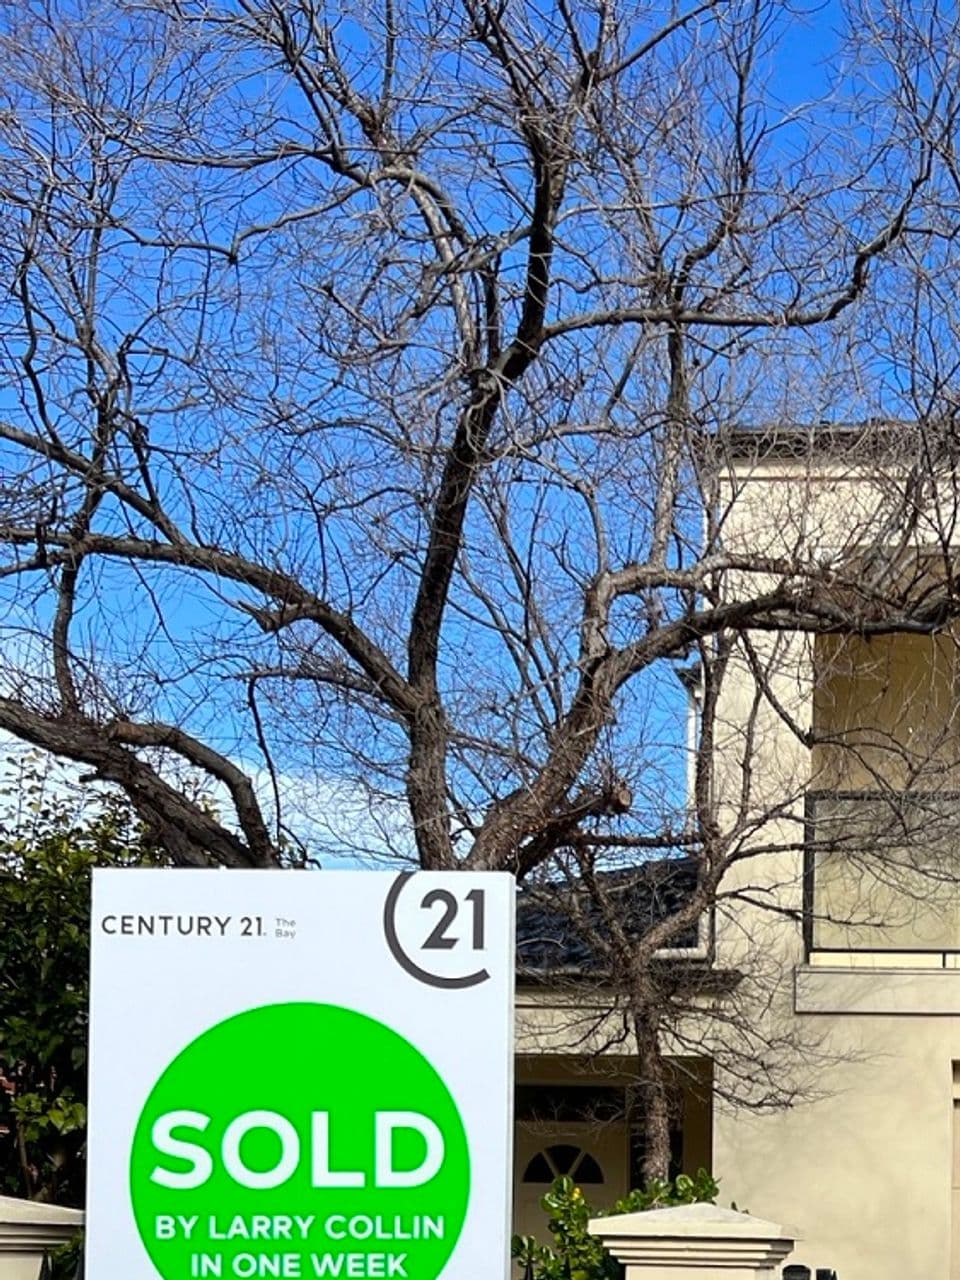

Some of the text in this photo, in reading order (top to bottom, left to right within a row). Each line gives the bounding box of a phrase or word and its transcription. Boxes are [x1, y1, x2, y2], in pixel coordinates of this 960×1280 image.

[101, 915, 232, 937] CENTURY
[275, 918, 297, 927] The
[275, 929, 297, 939] Bay
[150, 1109, 446, 1190] SOLD
[155, 1215, 445, 1240] BY LARRY COLLIN
[191, 1253, 408, 1278] IN ONE WEEK
